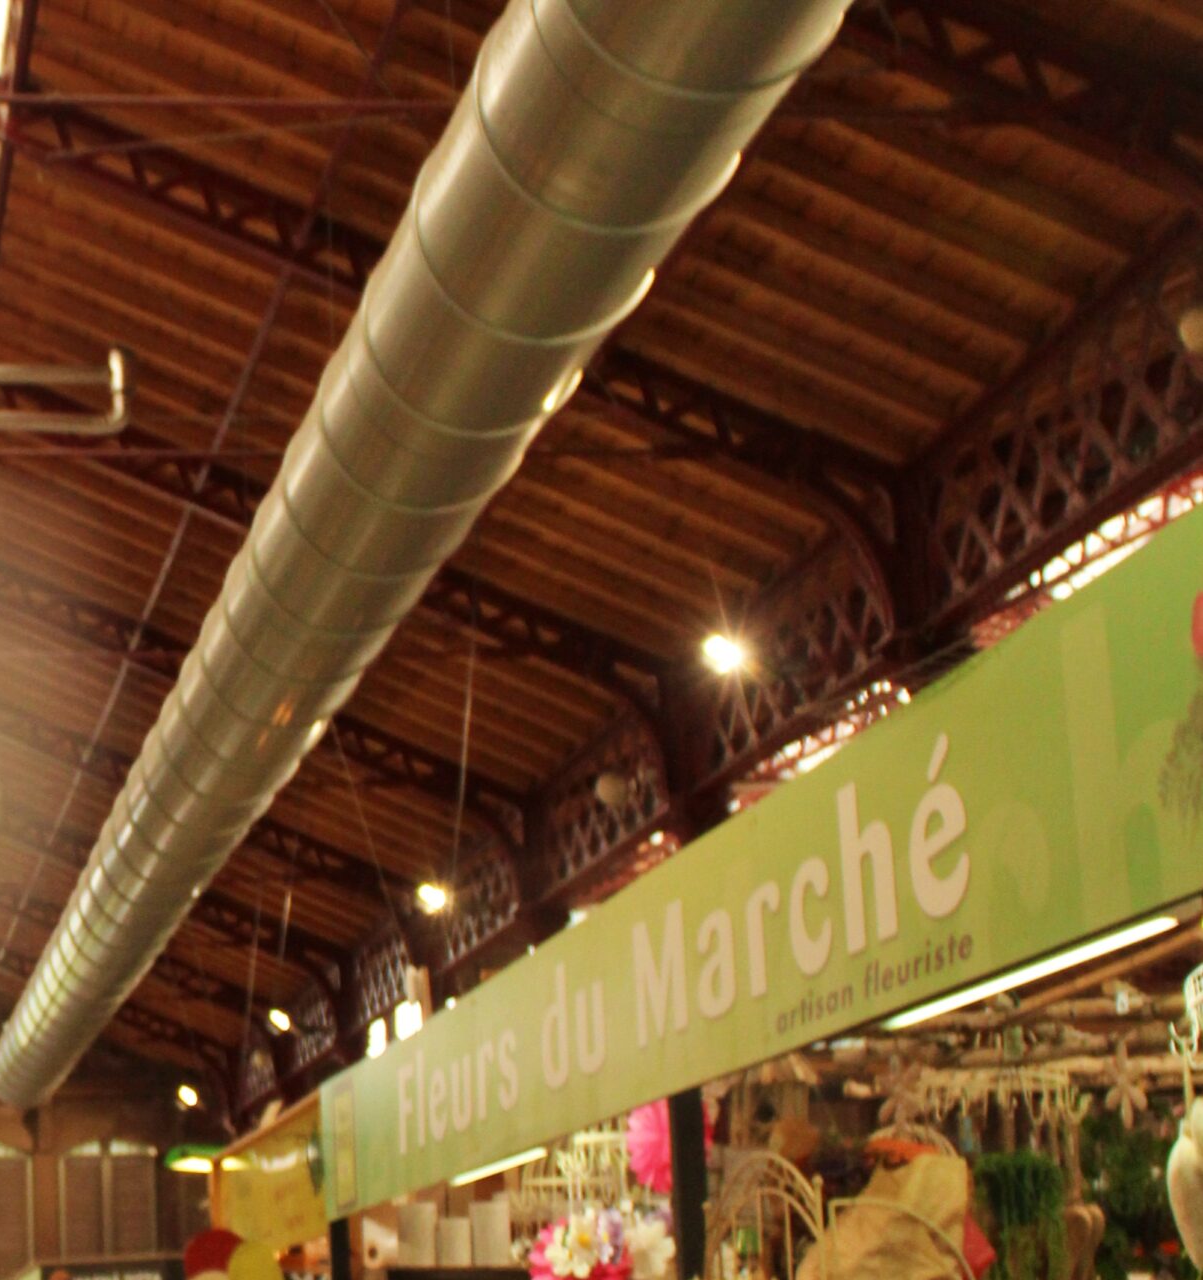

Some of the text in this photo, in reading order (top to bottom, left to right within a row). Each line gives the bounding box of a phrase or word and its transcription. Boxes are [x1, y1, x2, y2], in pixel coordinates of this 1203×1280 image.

[397, 733, 971, 1155] Fleurs du Marché
[775, 933, 975, 1036] artisan fleuriste
